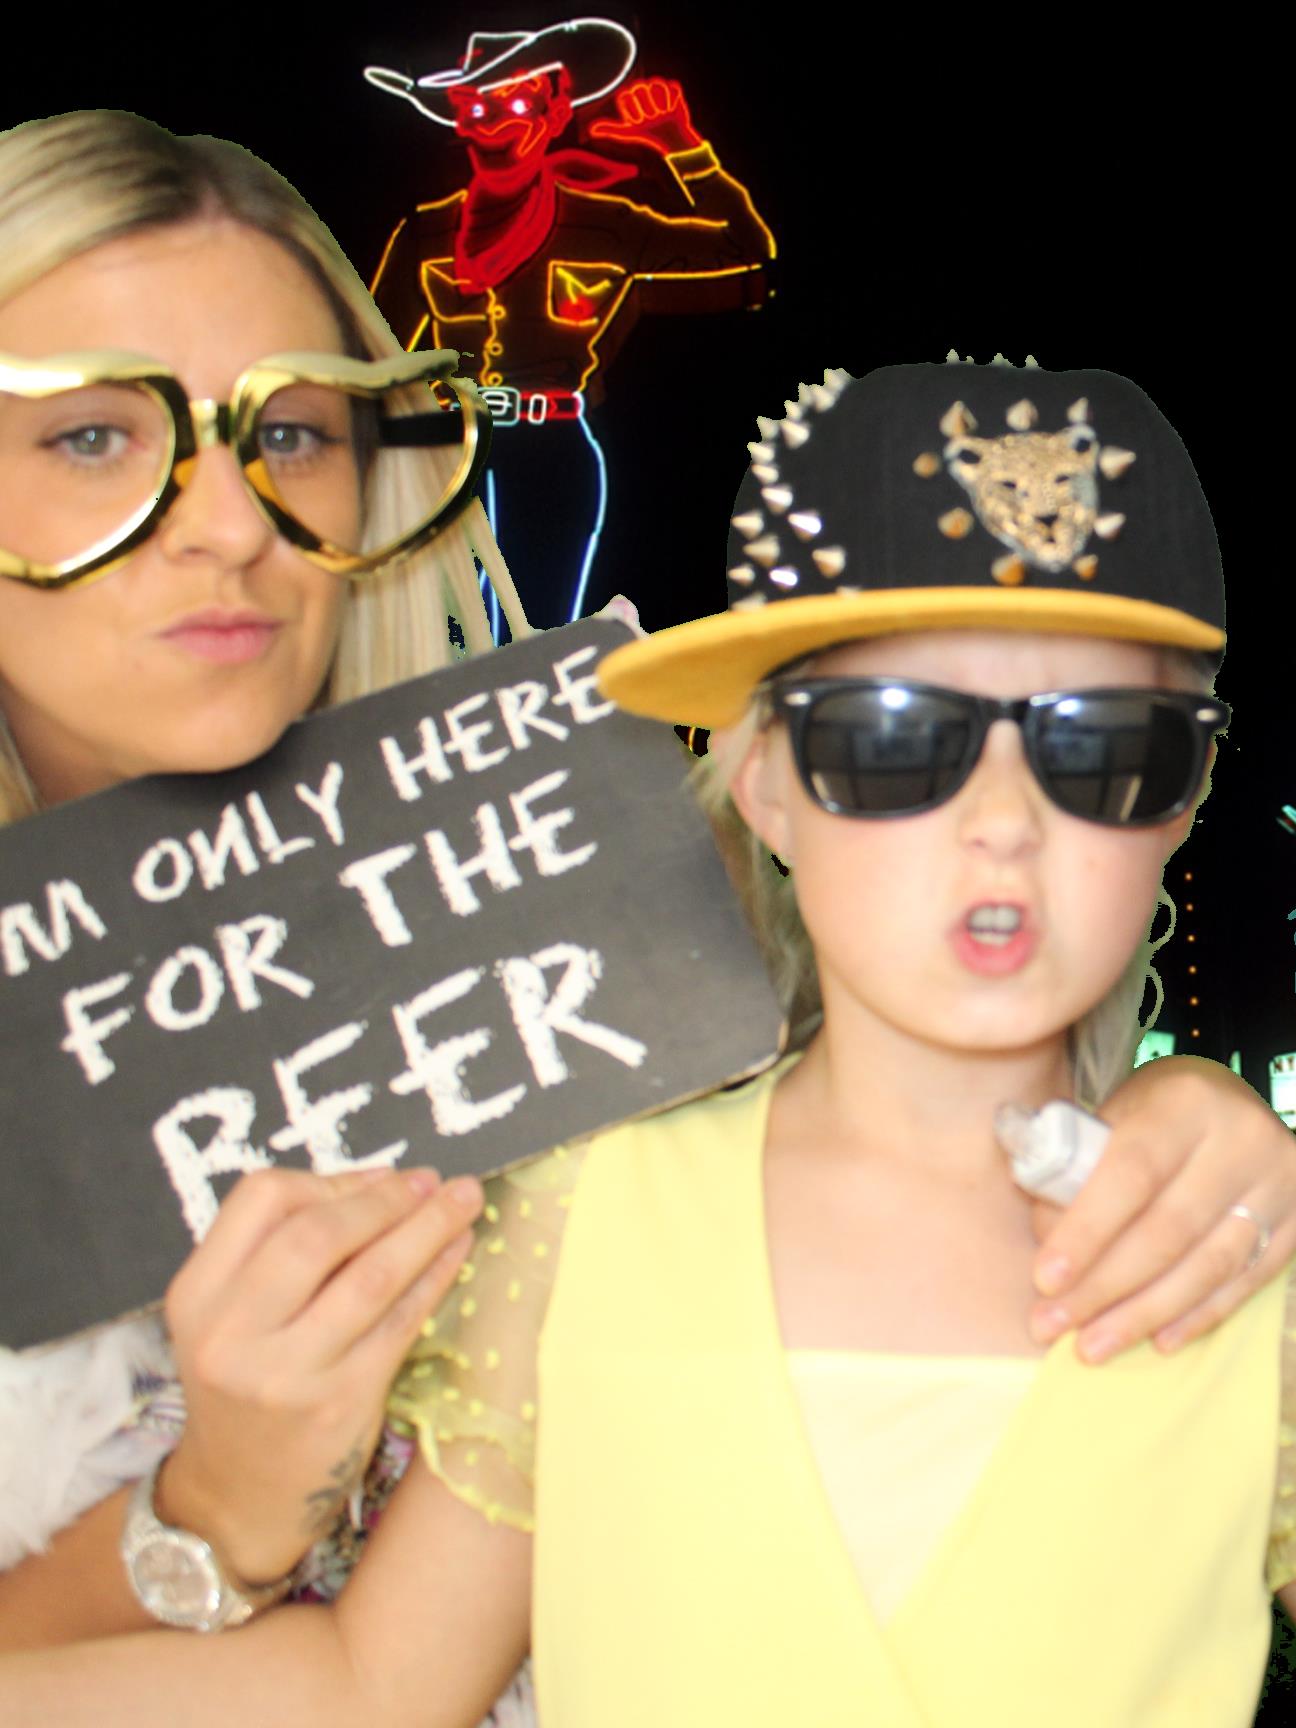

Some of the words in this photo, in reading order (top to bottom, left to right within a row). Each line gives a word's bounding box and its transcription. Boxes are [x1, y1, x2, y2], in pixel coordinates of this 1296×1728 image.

[135, 762, 344, 902] ONLY
[382, 646, 615, 802] HERE
[63, 914, 314, 1084] FOR
[339, 770, 597, 947] THE
